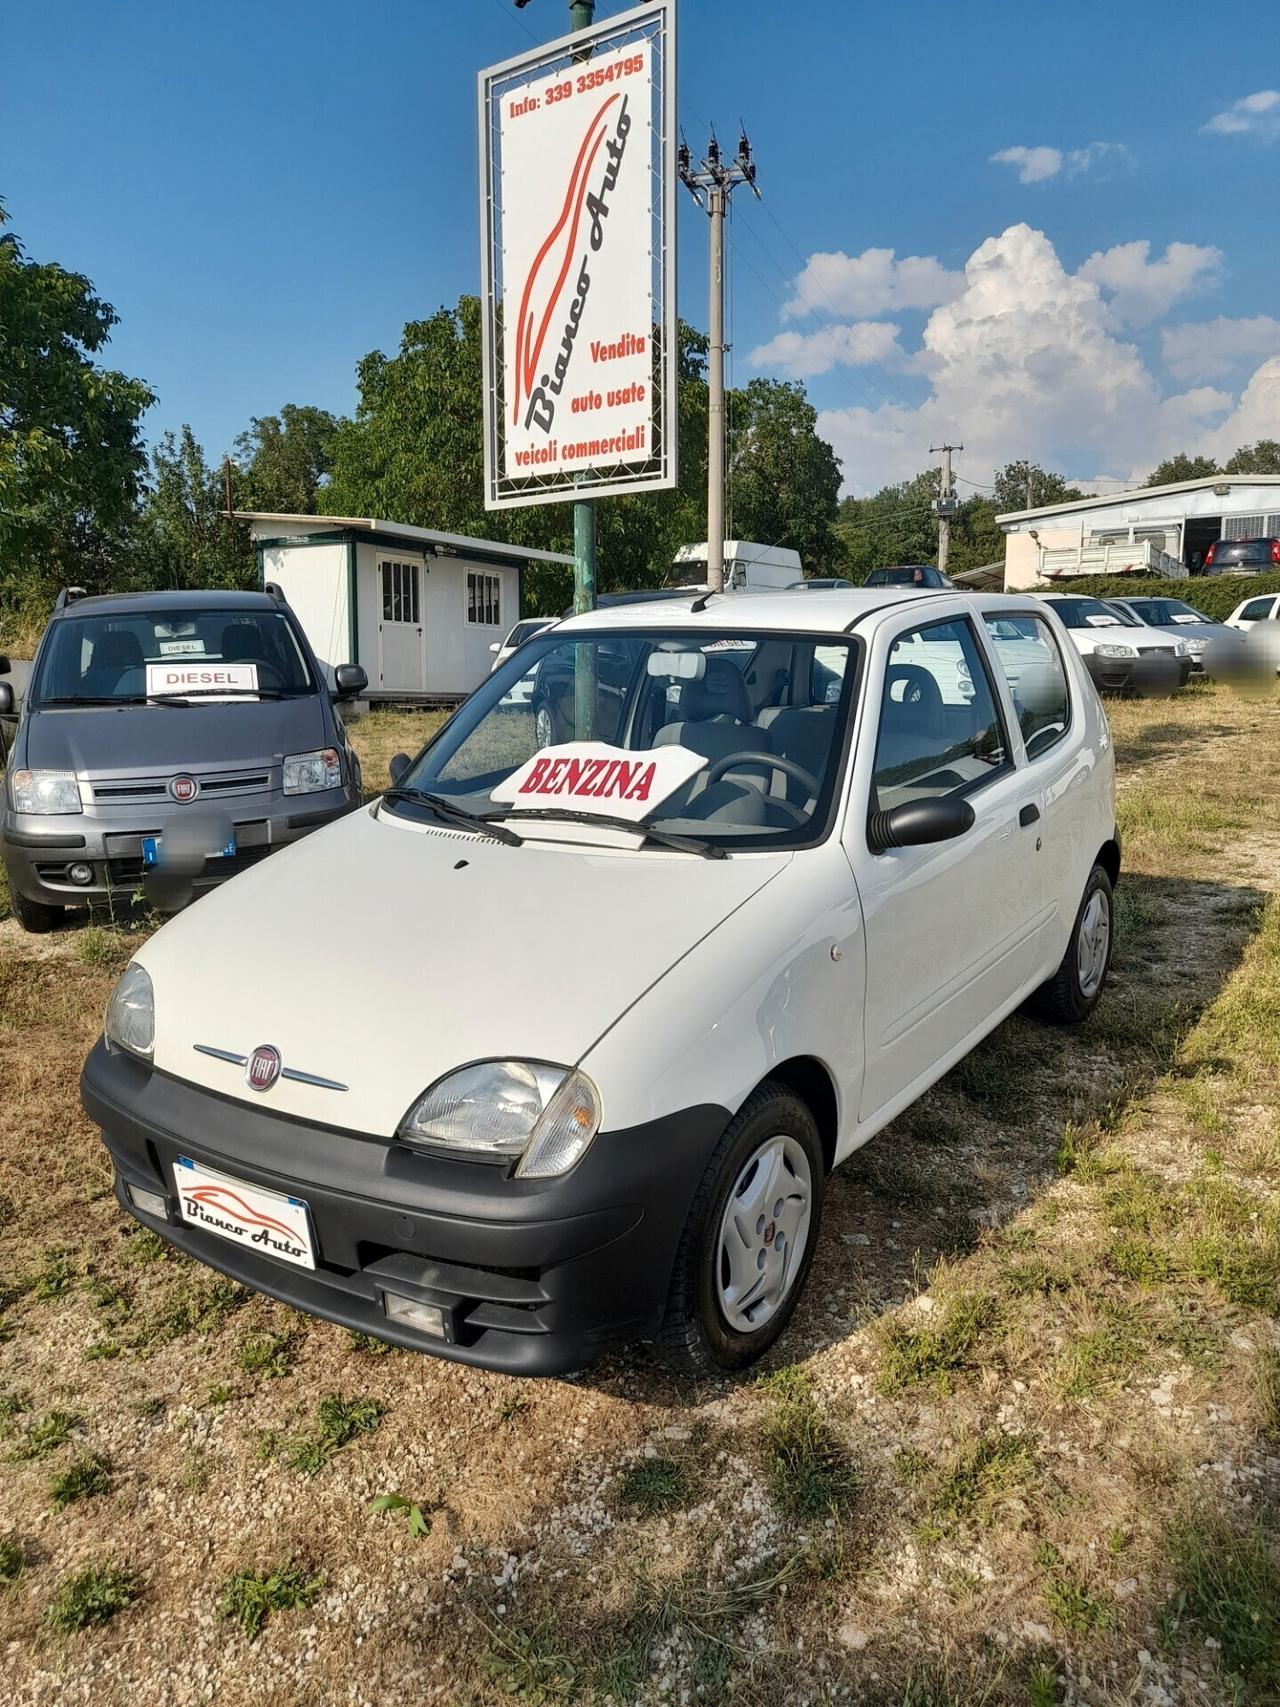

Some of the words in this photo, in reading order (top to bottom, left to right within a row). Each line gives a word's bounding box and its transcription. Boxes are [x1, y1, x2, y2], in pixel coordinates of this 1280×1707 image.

[510, 96, 541, 118] Info:
[545, 80, 573, 105] 339
[576, 53, 644, 93] 3354795
[524, 254, 591, 434] Bianco
[585, 94, 631, 251] Auto
[590, 332, 646, 363] Vendita
[571, 390, 602, 413] auto
[607, 382, 646, 407] usate
[515, 439, 558, 466] veicoli
[561, 425, 646, 458] commerciali
[166, 673, 239, 684] DIESEL
[518, 758, 656, 800] BENZINA
[251, 1056, 275, 1080] FIAT
[183, 1196, 248, 1236] Bianco
[251, 1229, 307, 1257] Auto
